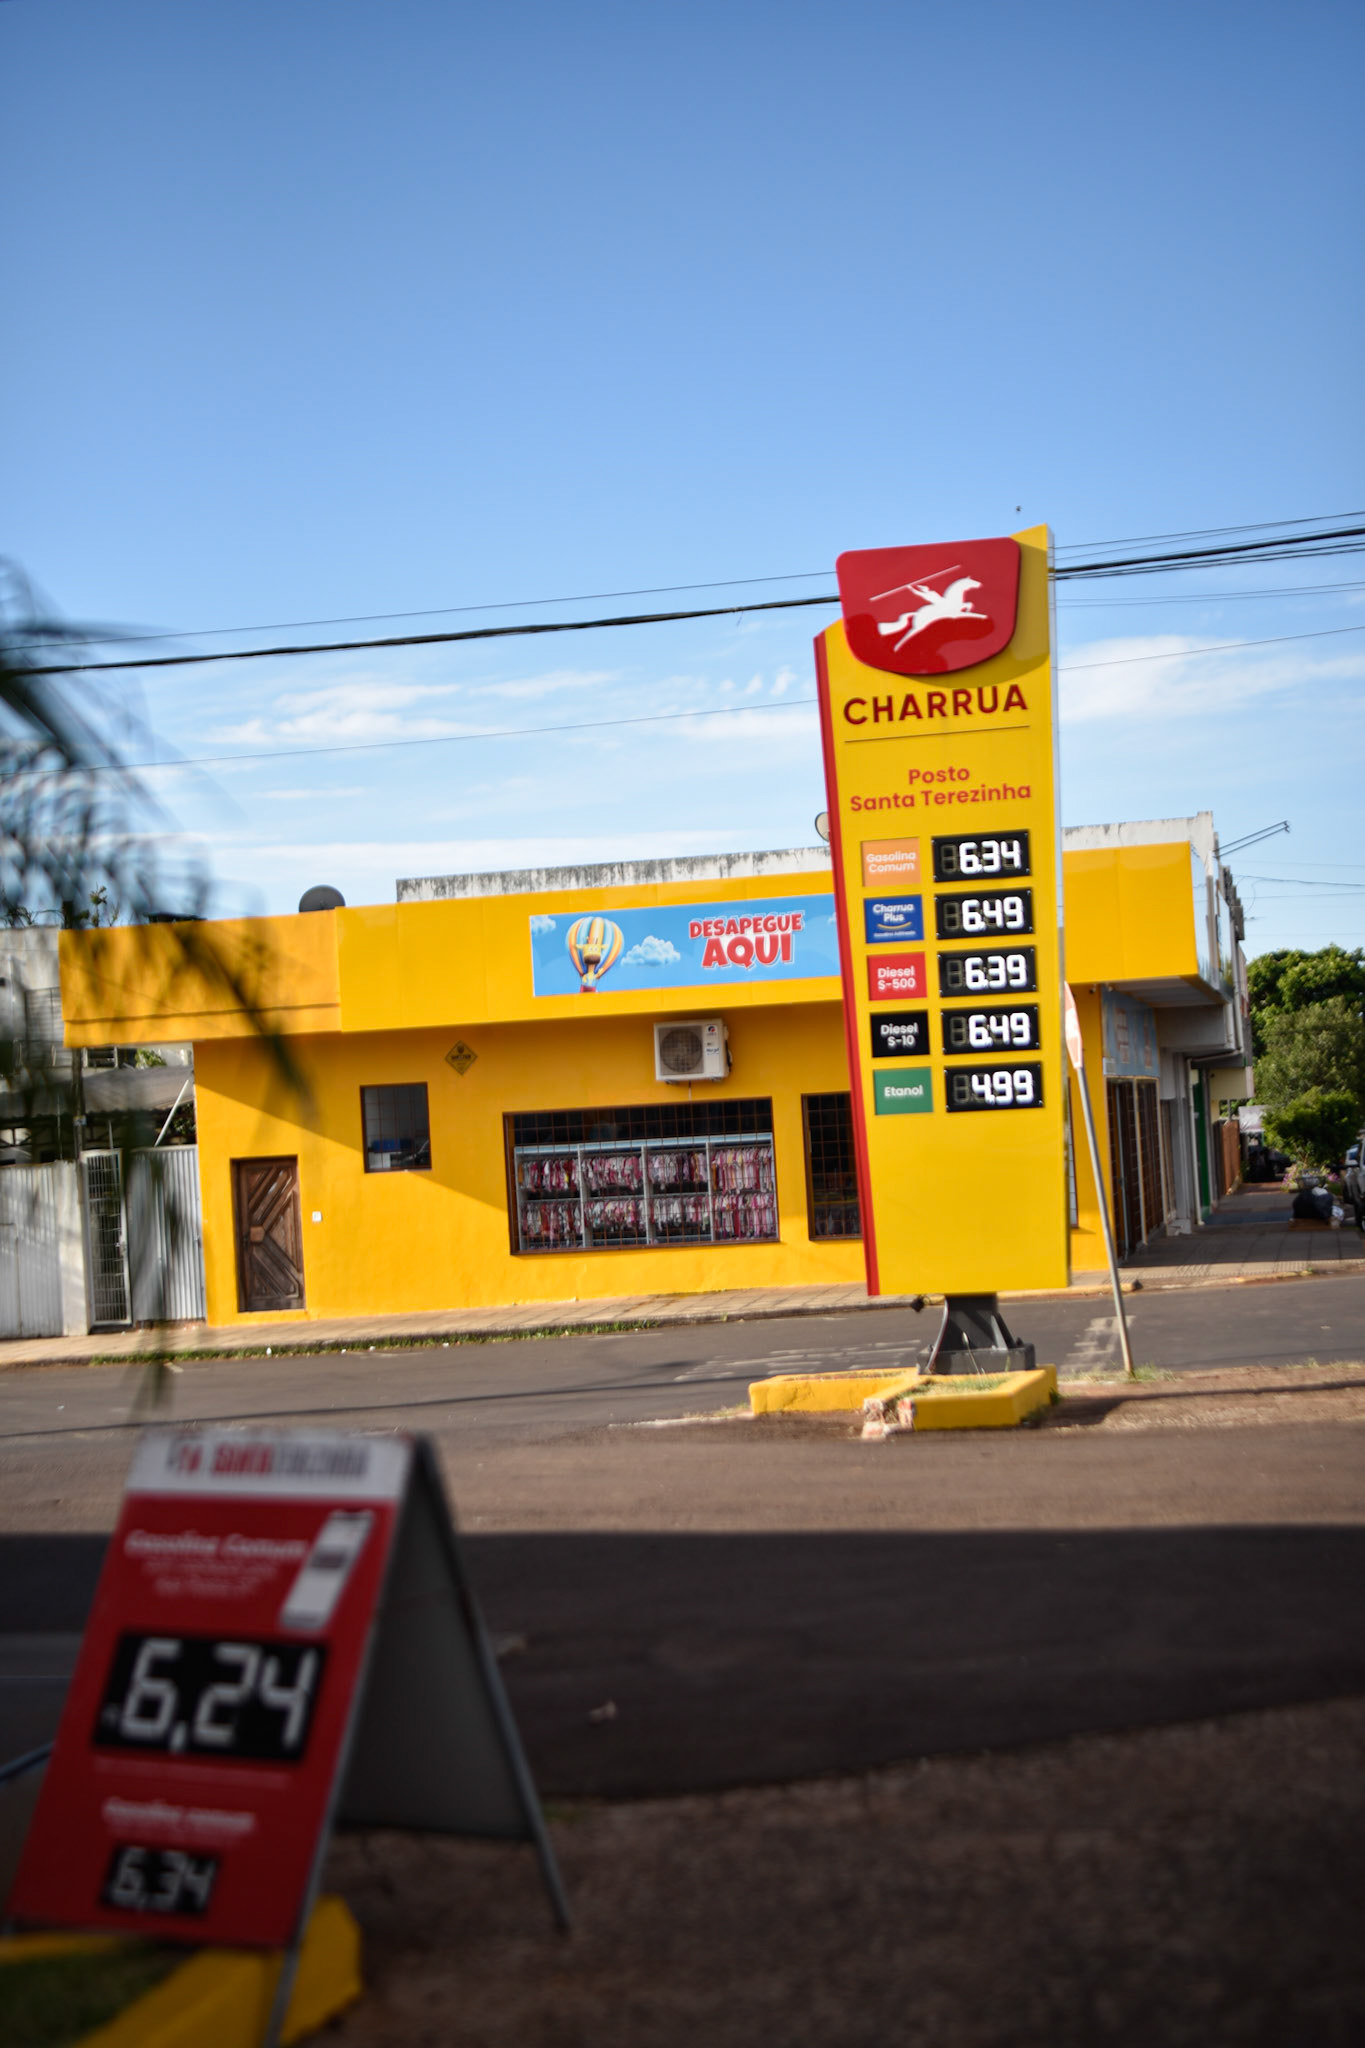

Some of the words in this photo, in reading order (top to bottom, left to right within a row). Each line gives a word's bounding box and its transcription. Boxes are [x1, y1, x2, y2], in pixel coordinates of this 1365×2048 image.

[843, 683, 1029, 725] CHARRUA
[908, 765, 970, 785] Posto
[850, 792, 915, 812] Santa
[921, 783, 1031, 807] Terezinha
[866, 851, 916, 864] Gasolina
[868, 861, 916, 873] Comum
[873, 902, 915, 914] Charrua
[883, 913, 905, 923] Plus
[689, 912, 804, 939] DESAPEGUE
[702, 932, 794, 967] AQUI
[877, 965, 916, 979] Diesel
[877, 978, 916, 990] S-500
[880, 1022, 919, 1036] Diesel
[887, 1035, 915, 1047] S-10
[884, 1084, 923, 1098] Etanol
[121, 1638, 321, 1754] 6,24
